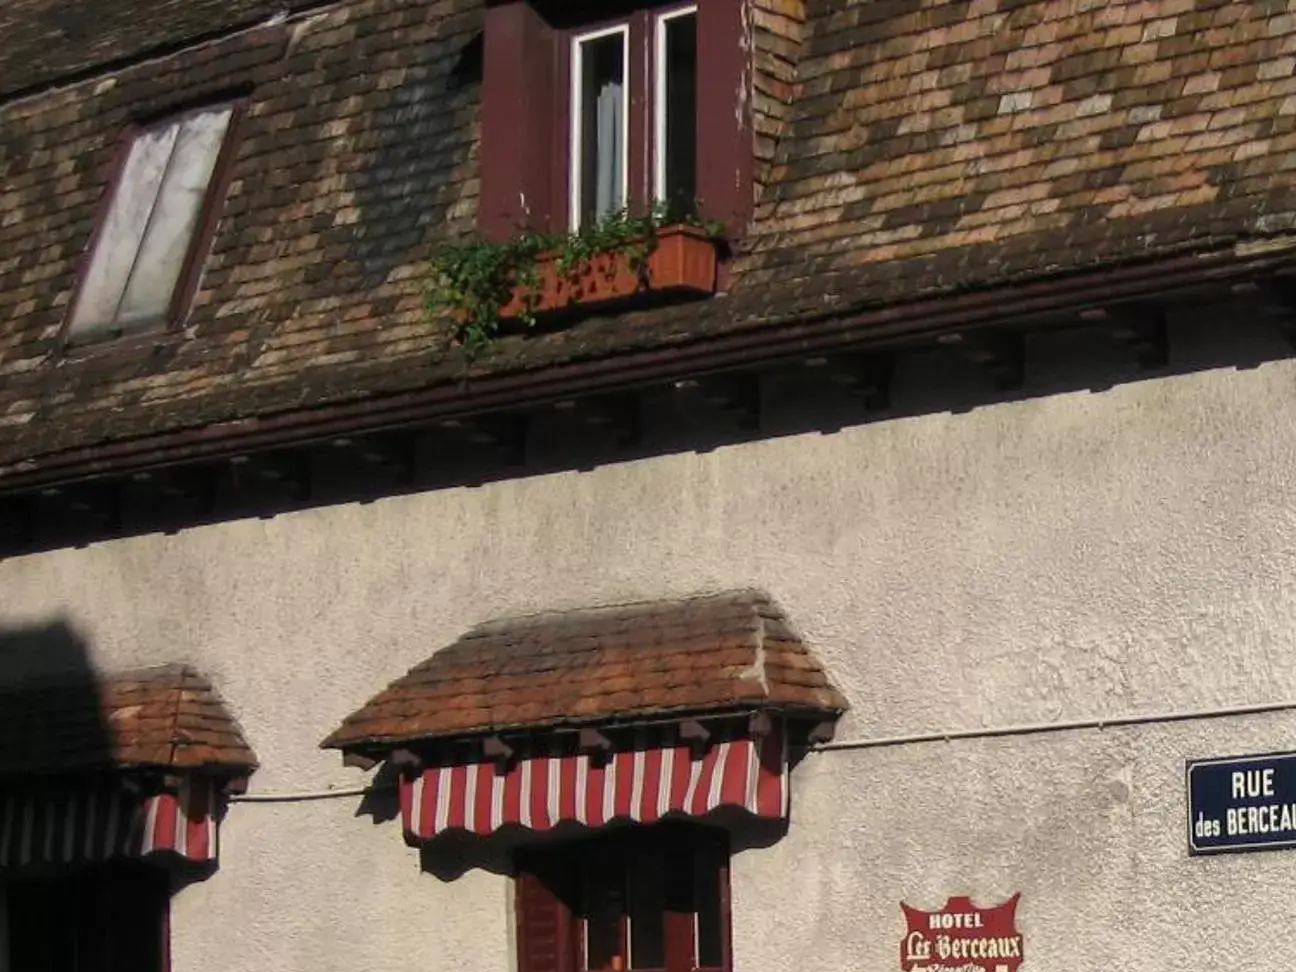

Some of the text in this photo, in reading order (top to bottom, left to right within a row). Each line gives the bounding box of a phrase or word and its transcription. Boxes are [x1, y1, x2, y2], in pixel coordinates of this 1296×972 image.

[1231, 768, 1275, 799] RUE
[1195, 811, 1221, 838] des
[929, 912, 984, 929] HOTEL
[936, 934, 1021, 959] Berceaux
